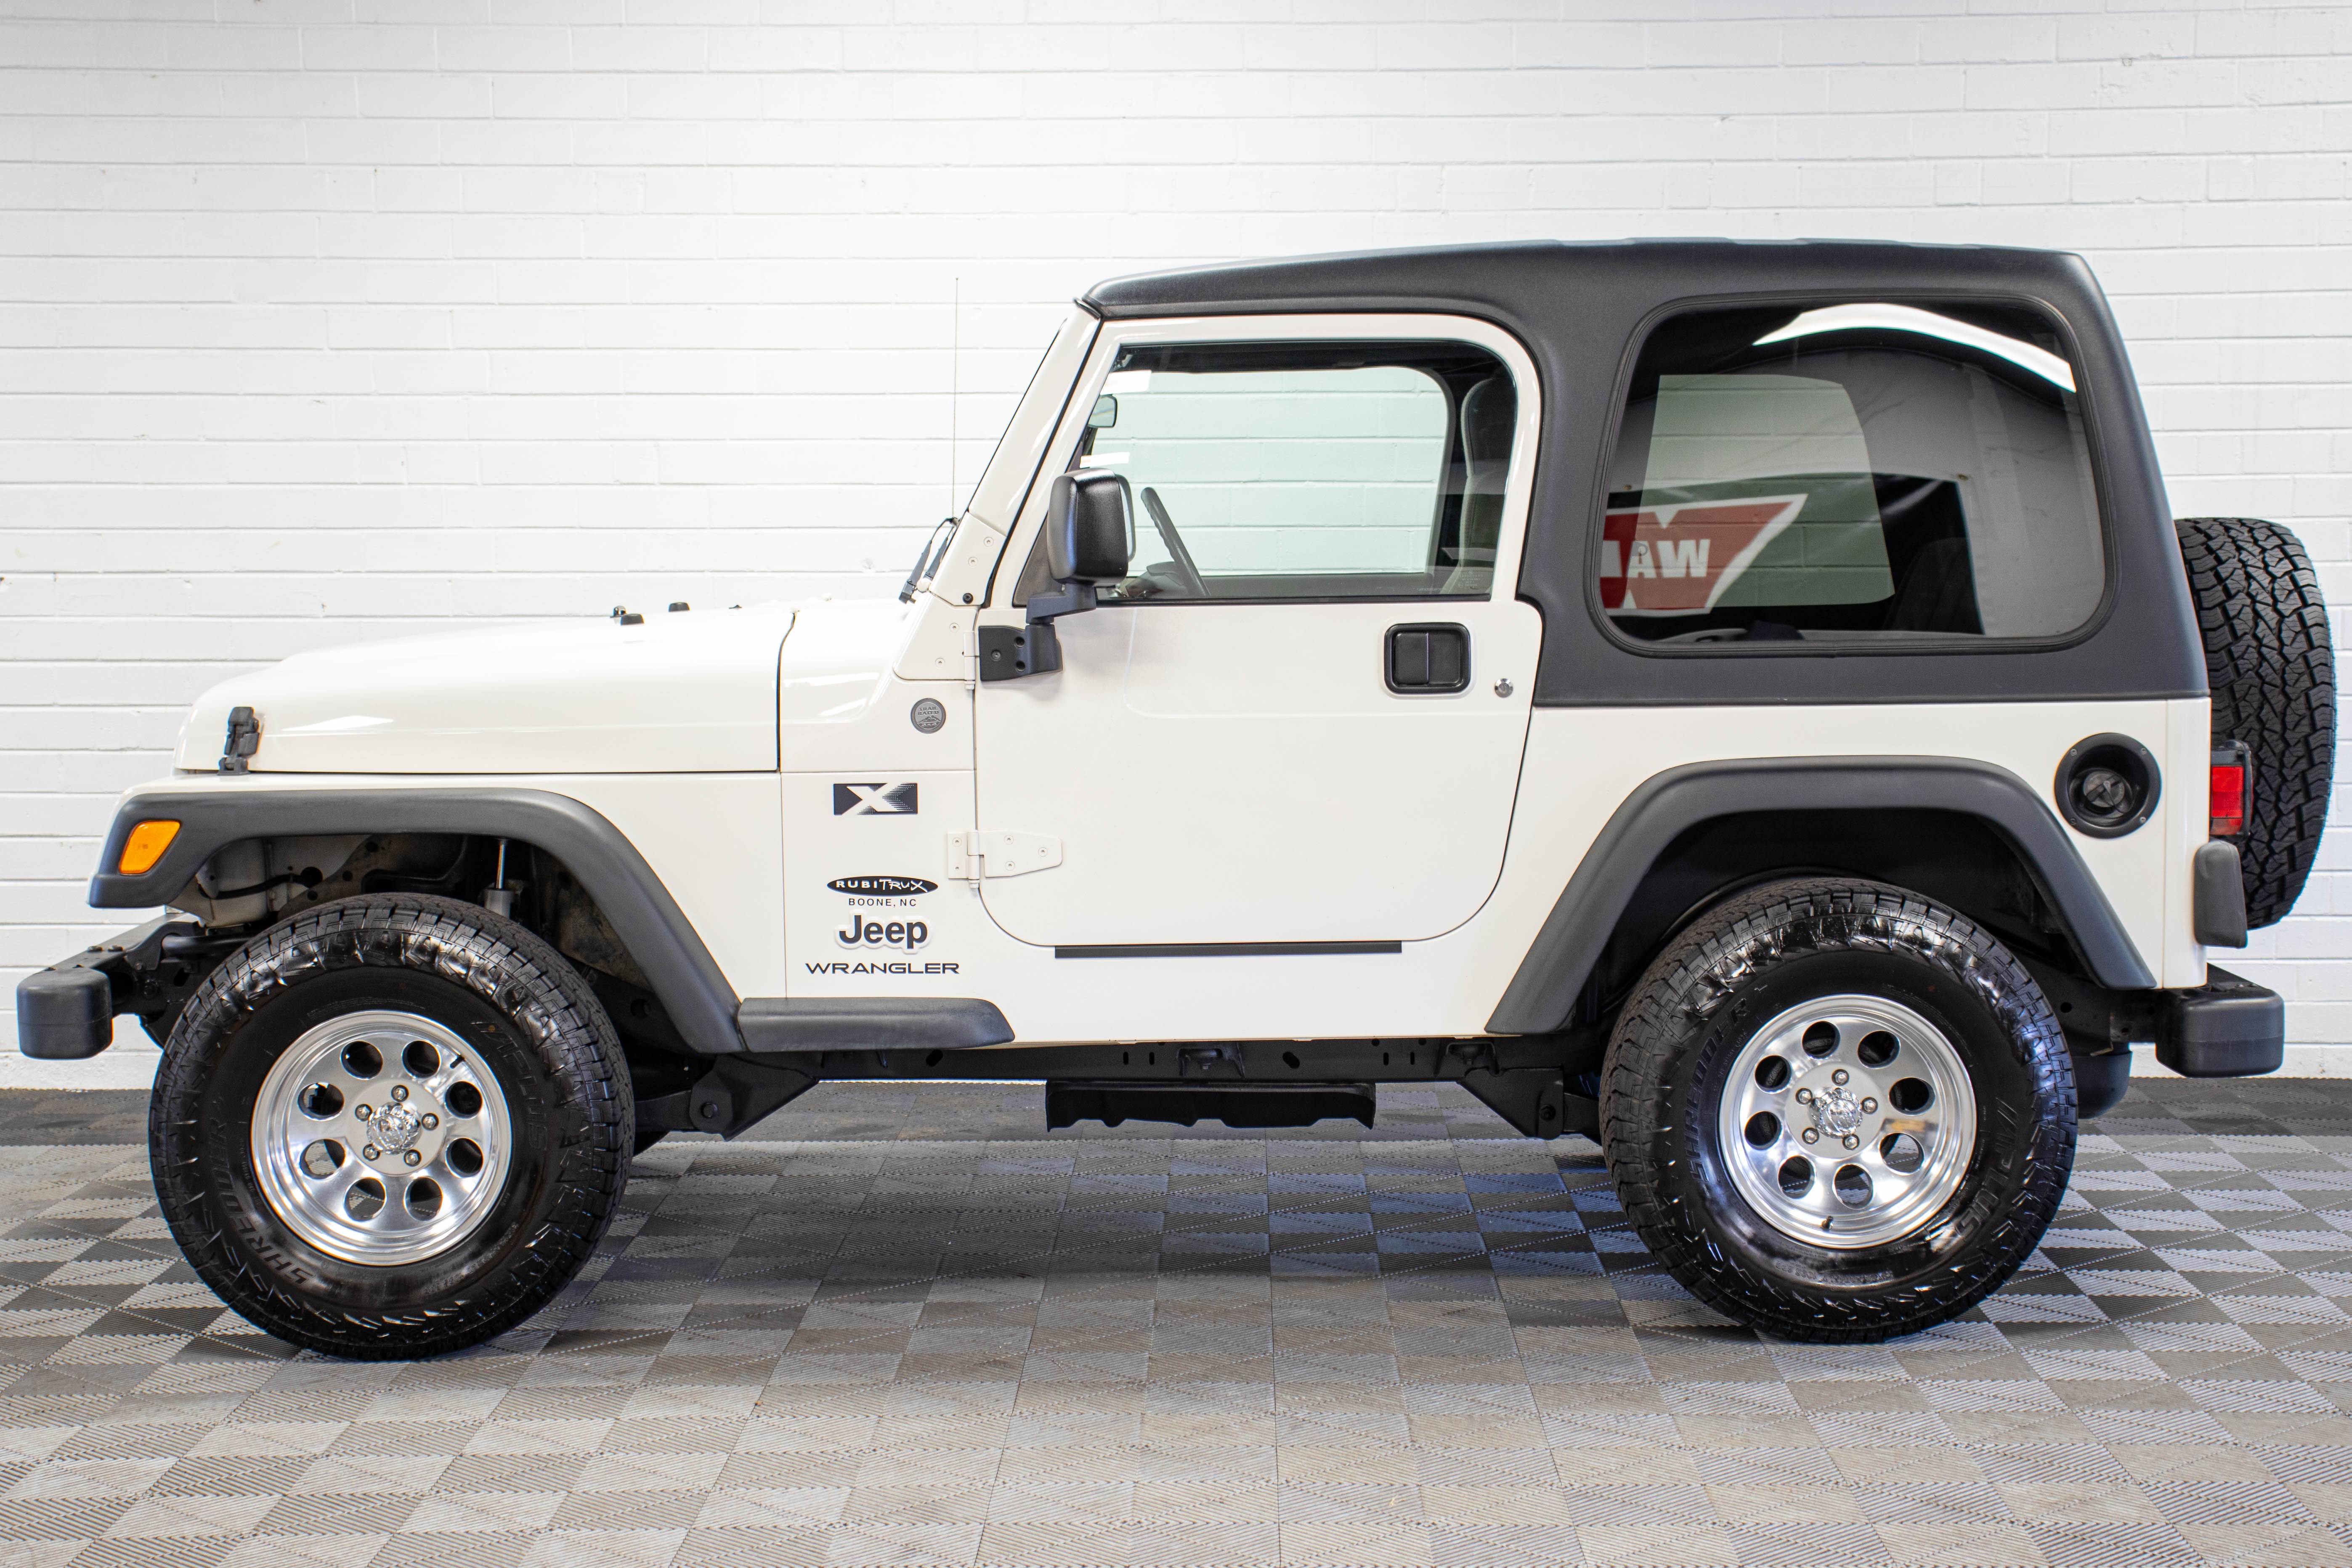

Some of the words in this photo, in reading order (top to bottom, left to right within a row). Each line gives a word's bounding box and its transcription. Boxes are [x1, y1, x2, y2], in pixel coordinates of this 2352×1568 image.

[848, 898, 896, 907] BOONE,
[839, 915, 928, 950] Jeep
[805, 963, 960, 974] WRANGLER
